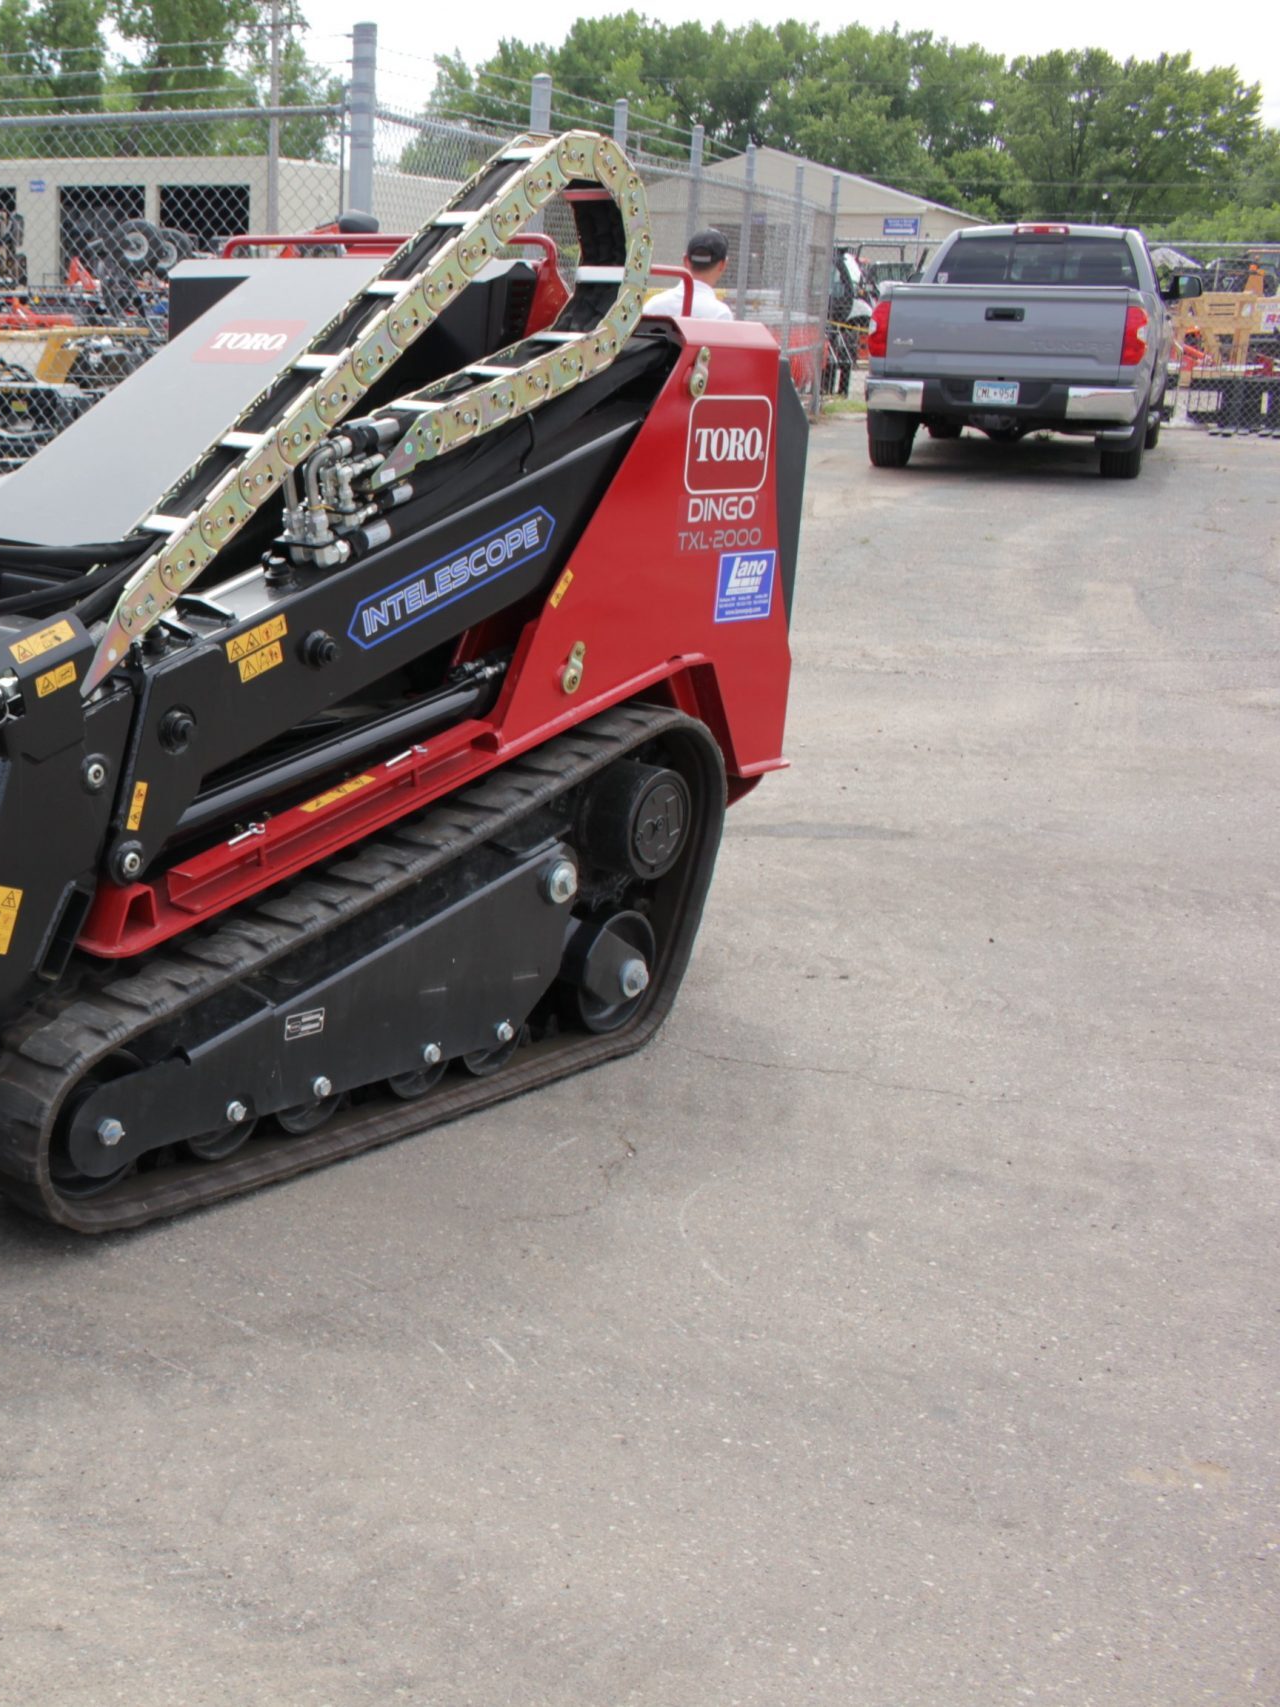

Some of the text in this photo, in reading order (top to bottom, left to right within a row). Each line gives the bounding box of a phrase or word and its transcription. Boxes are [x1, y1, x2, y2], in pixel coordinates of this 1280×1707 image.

[210, 332, 288, 351] TORO
[695, 427, 764, 462] TORO
[687, 496, 756, 523] DINGO
[362, 518, 540, 637] INTELESCOPE
[728, 556, 768, 583] Lano
